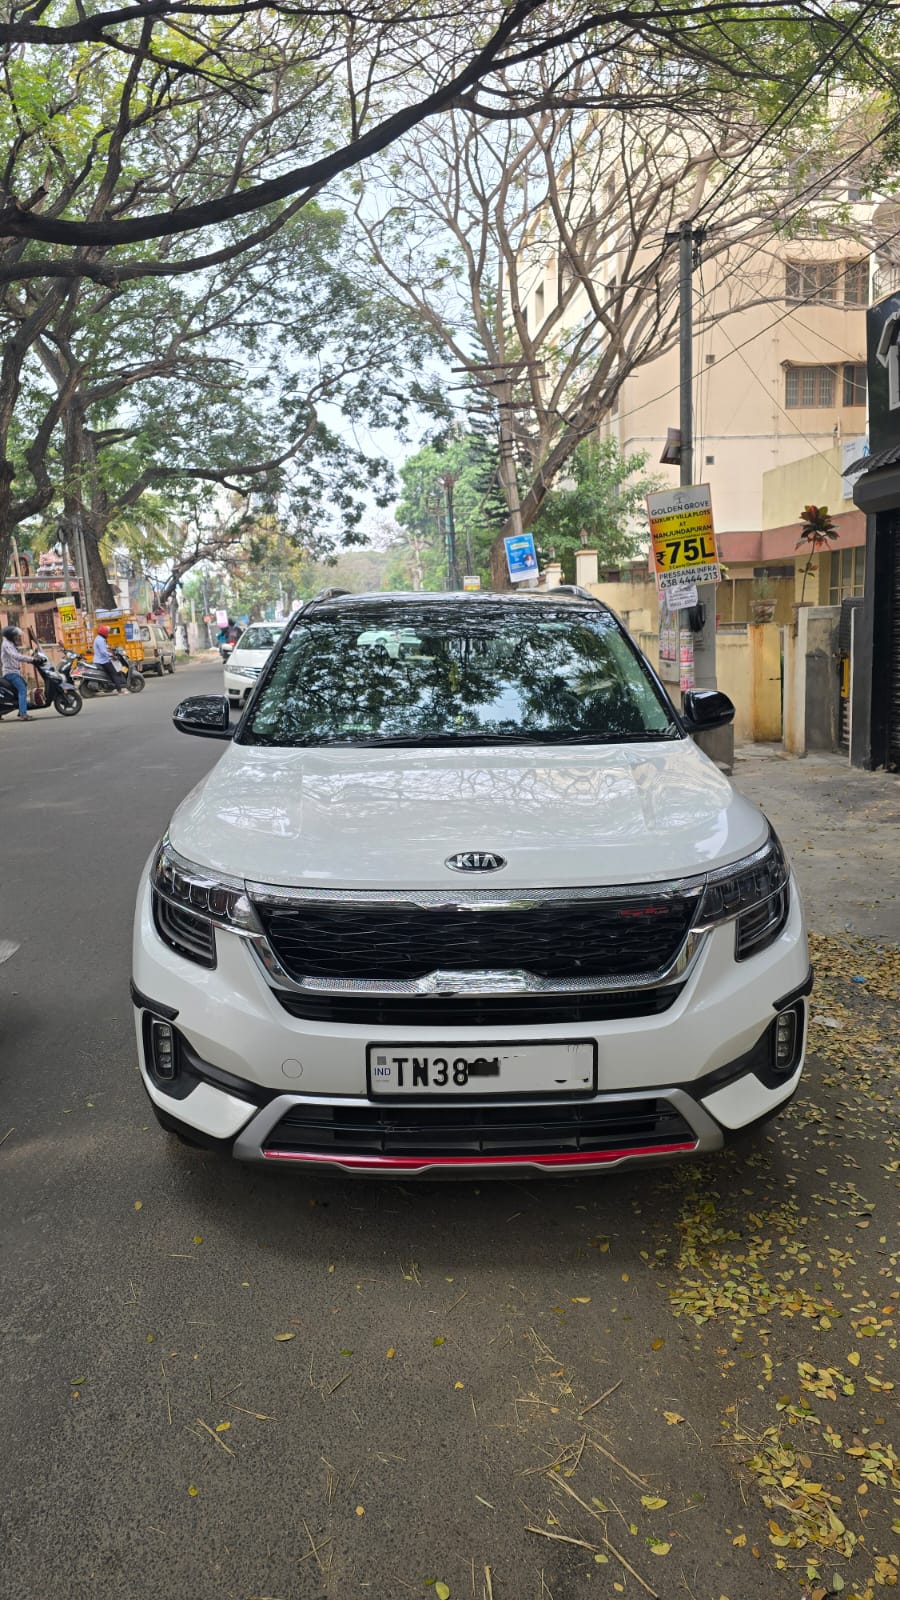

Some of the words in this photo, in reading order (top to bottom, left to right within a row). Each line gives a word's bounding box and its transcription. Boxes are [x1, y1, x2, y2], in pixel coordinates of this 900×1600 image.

[651, 504, 683, 516] GOLDEN
[684, 500, 709, 510] GROVE
[651, 515, 675, 525] LUXURY
[675, 512, 692, 520] VILLA
[693, 509, 711, 517] PLOTS
[653, 524, 712, 539] NANJUNDAPURAM
[659, 568, 696, 580] PRESSANA
[696, 565, 717, 574] INFRA
[660, 578, 678, 589] 638
[679, 574, 702, 585] 4444
[703, 571, 718, 581] 213
[456, 853, 498, 868] KIA
[374, 1067, 391, 1076] IND
[392, 1057, 500, 1087] TN38
